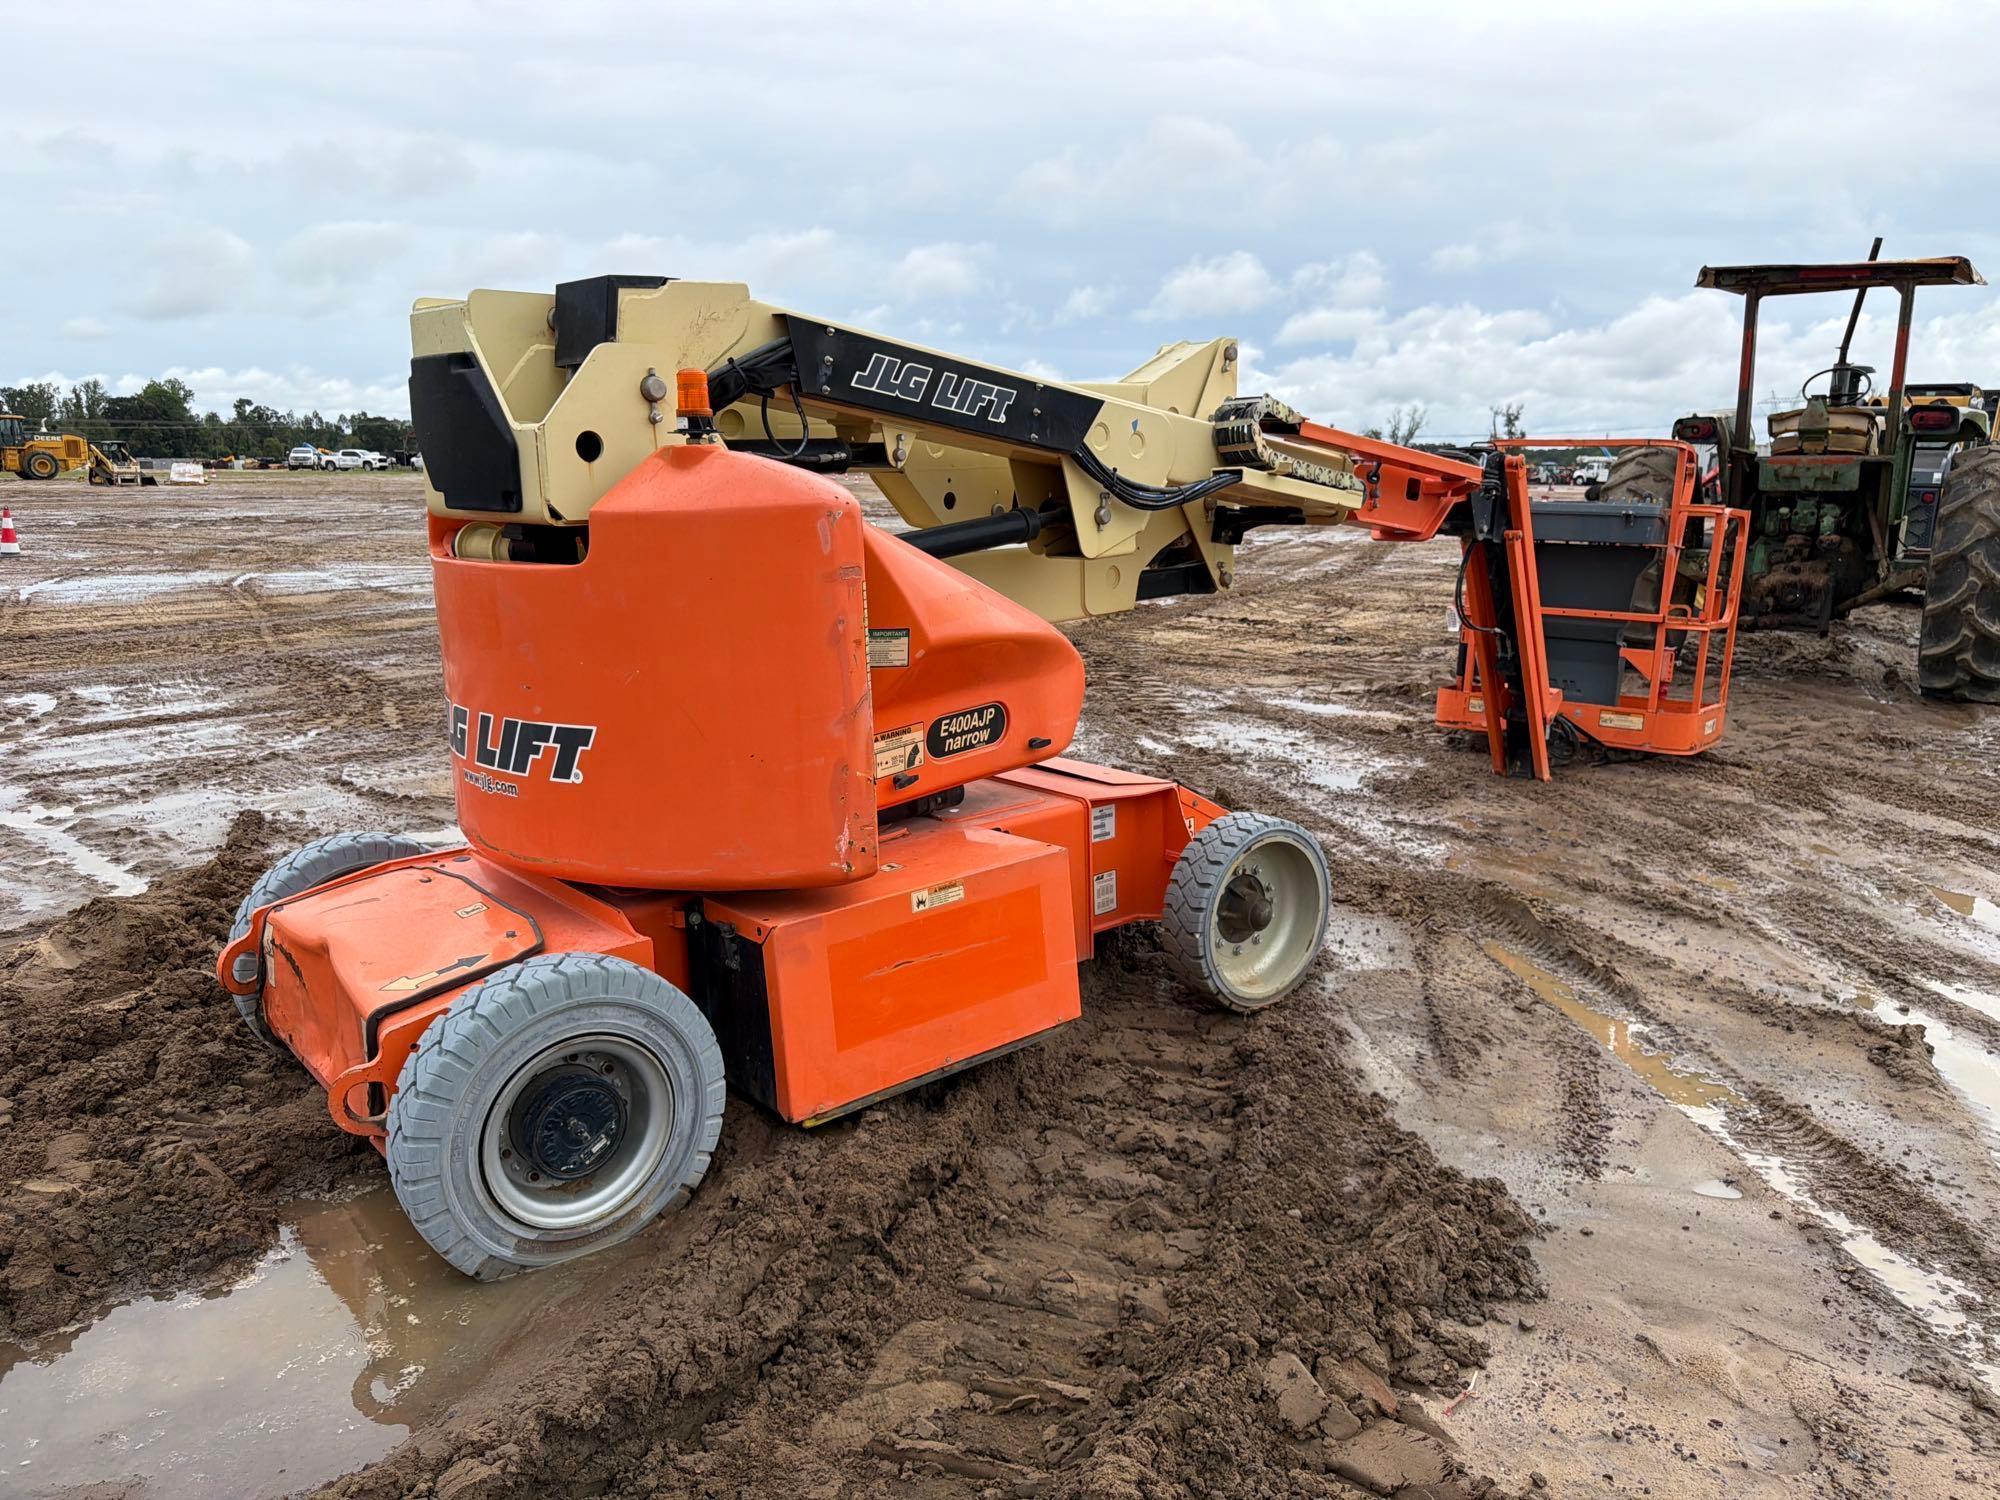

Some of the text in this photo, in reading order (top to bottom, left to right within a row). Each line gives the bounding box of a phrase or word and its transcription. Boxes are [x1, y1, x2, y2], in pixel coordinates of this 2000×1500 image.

[851, 353, 1017, 423] JLG LIFT
[880, 727, 912, 741] WARNING
[940, 707, 996, 737] E400AJP
[475, 712, 598, 784] LIFT
[944, 728, 991, 752] narrow
[463, 768, 518, 797] www.jlg.com
